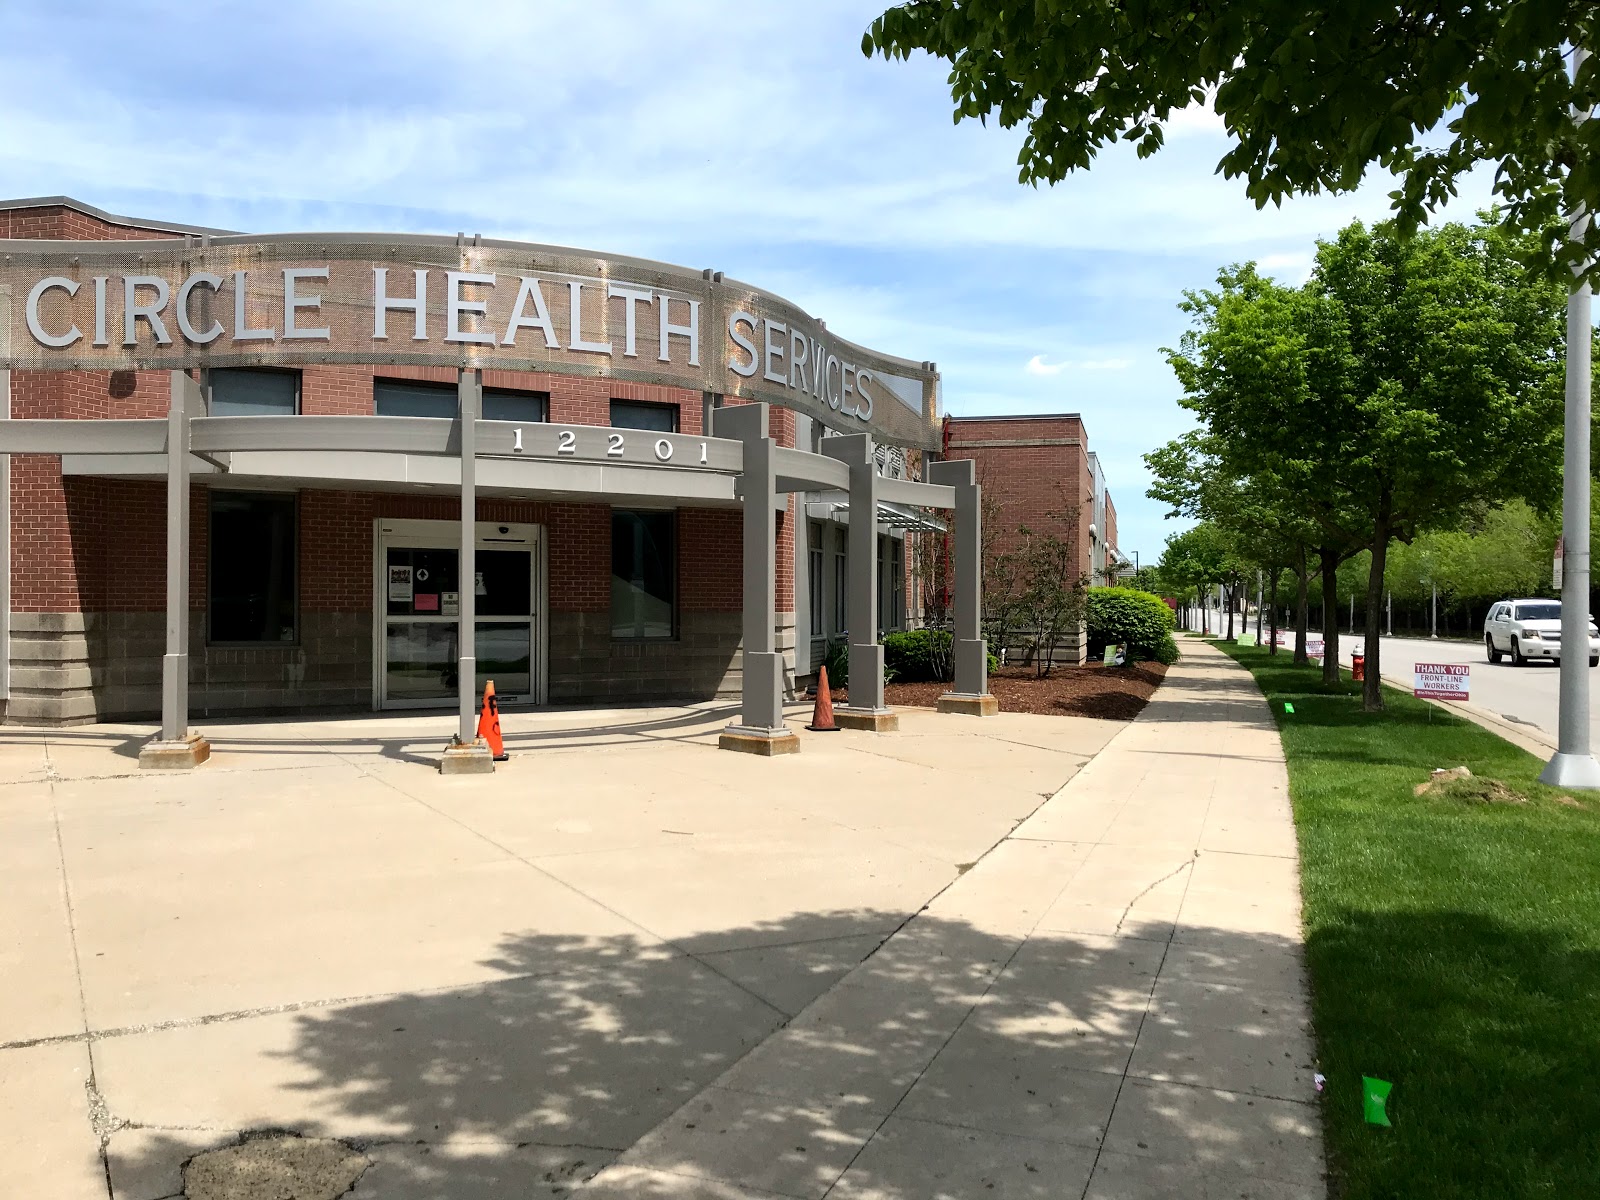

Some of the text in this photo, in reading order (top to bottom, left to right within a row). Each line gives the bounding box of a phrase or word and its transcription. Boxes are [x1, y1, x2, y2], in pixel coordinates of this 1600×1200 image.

[26, 265, 873, 421] CIRCLE HEALTH SERVICES
[513, 427, 708, 465] 12201
[1416, 665, 1446, 673] THANK
